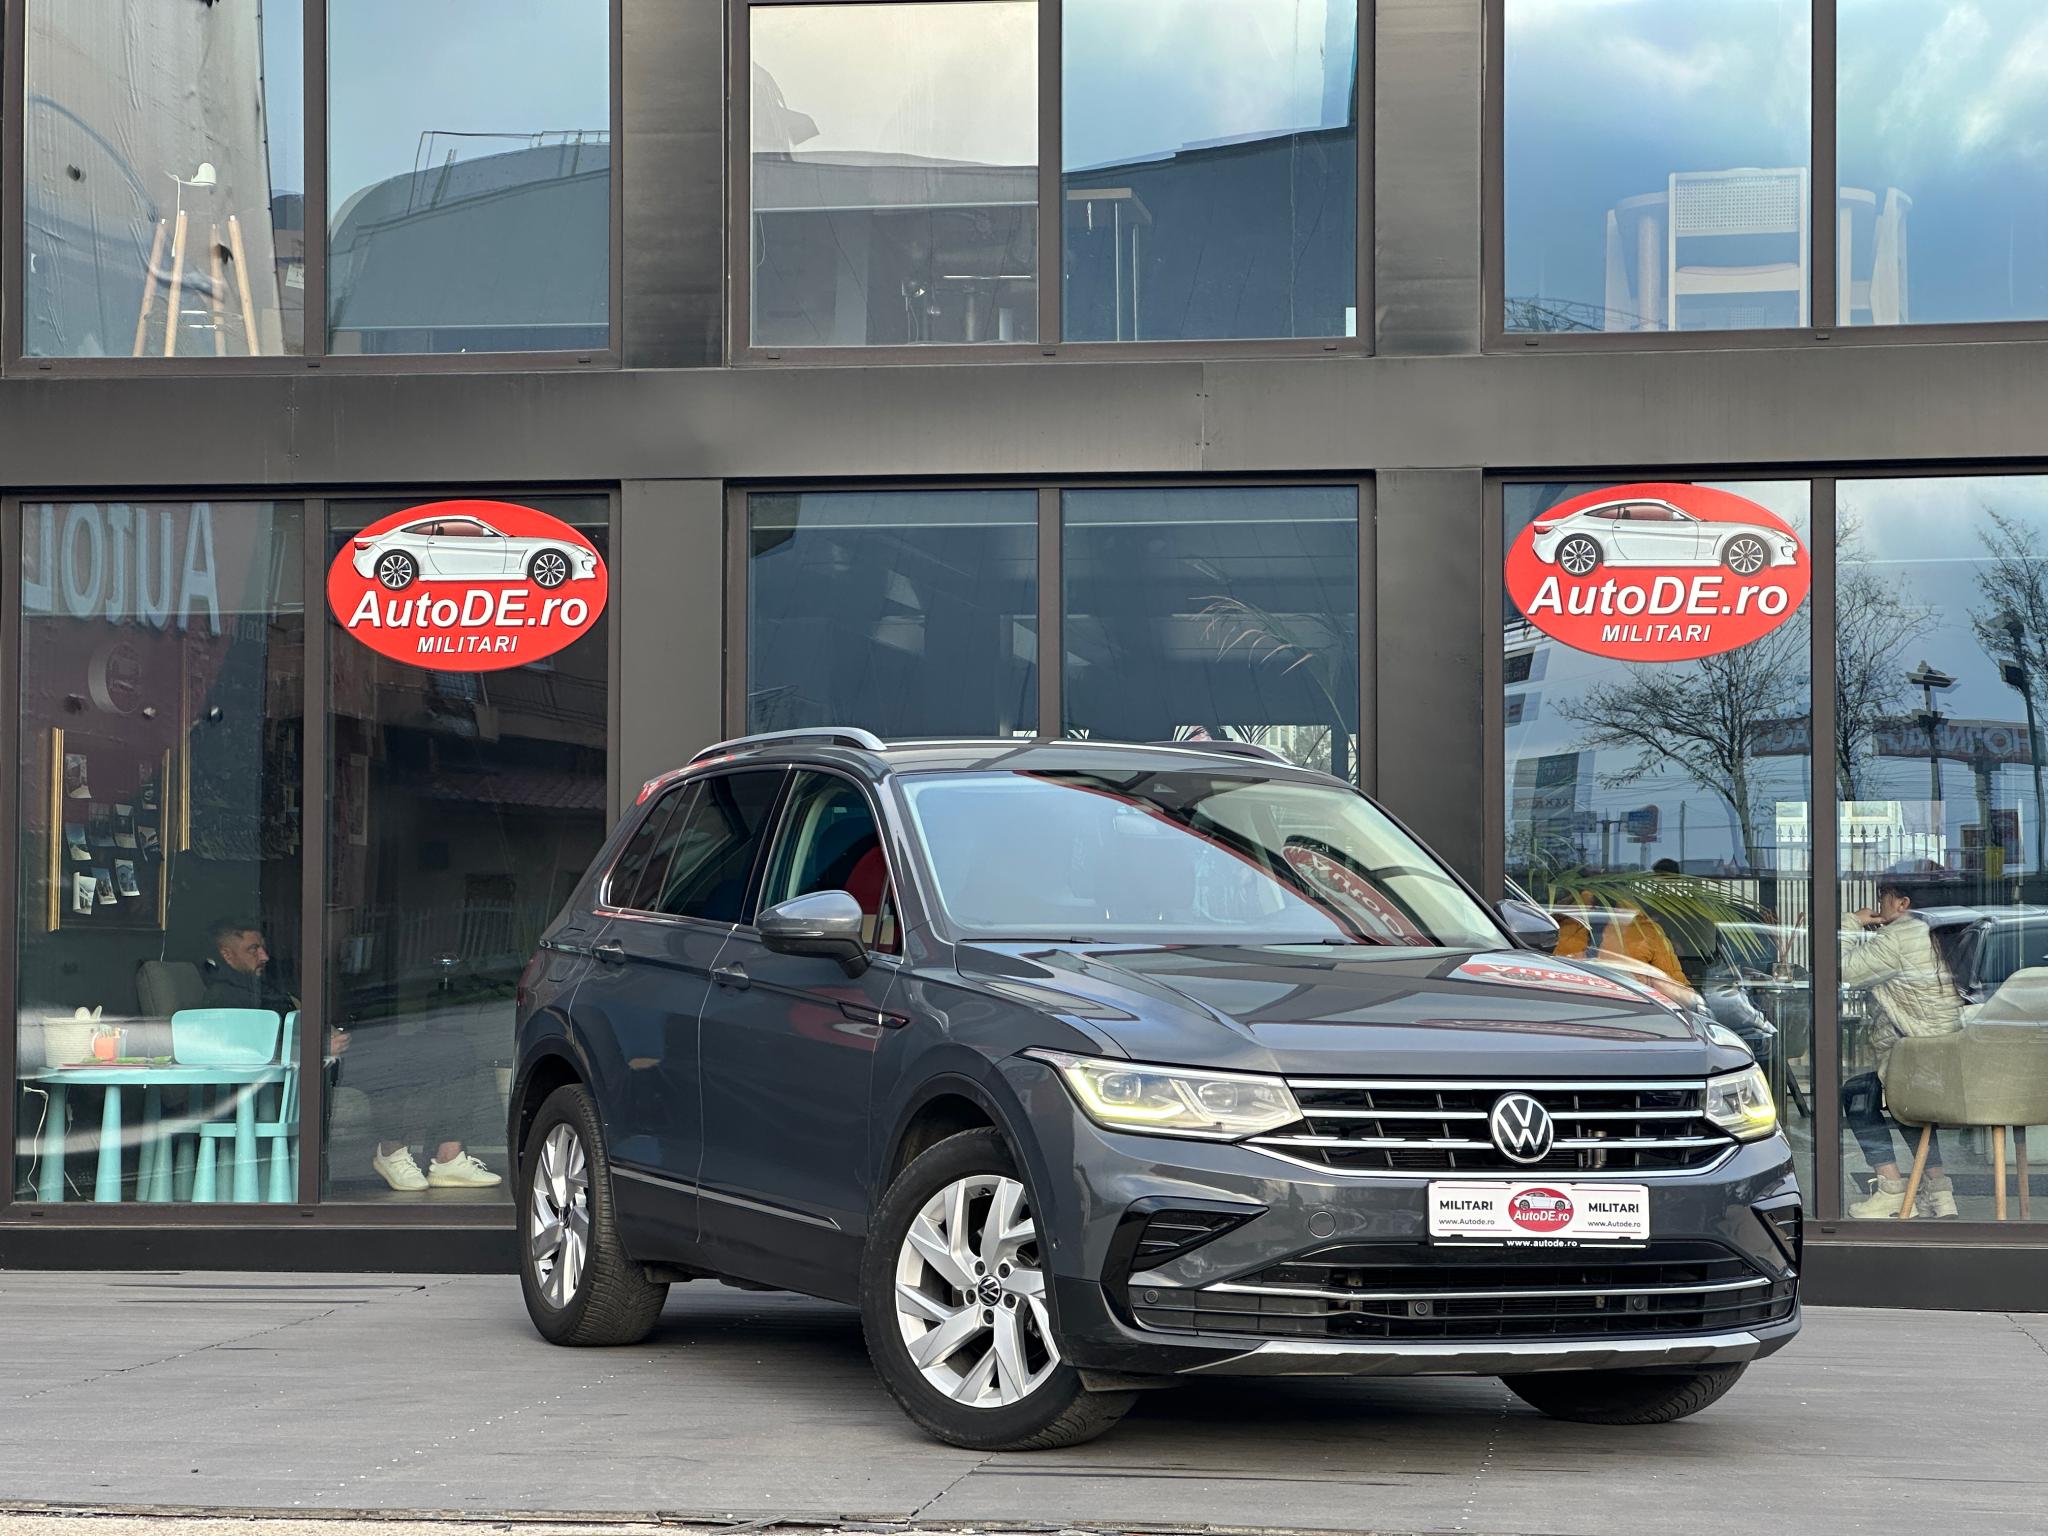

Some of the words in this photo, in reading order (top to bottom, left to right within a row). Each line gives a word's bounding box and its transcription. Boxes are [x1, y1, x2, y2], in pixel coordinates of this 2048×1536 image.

[1527, 575, 1788, 615] AutoDE.ro
[347, 589, 589, 628] AutoDE.ro
[1601, 624, 1711, 642] MILITARI
[416, 635, 519, 653] MILITARI
[1439, 1200, 1493, 1211] MILITARI
[1588, 1203, 1639, 1213] MILITARI
[1513, 1210, 1570, 1222] AutoDE.ro
[1438, 1218, 1495, 1226] www.Autode.ro
[1587, 1220, 1641, 1228] www.Autode.ro
[1506, 1239, 1578, 1248] www.autode.ro
